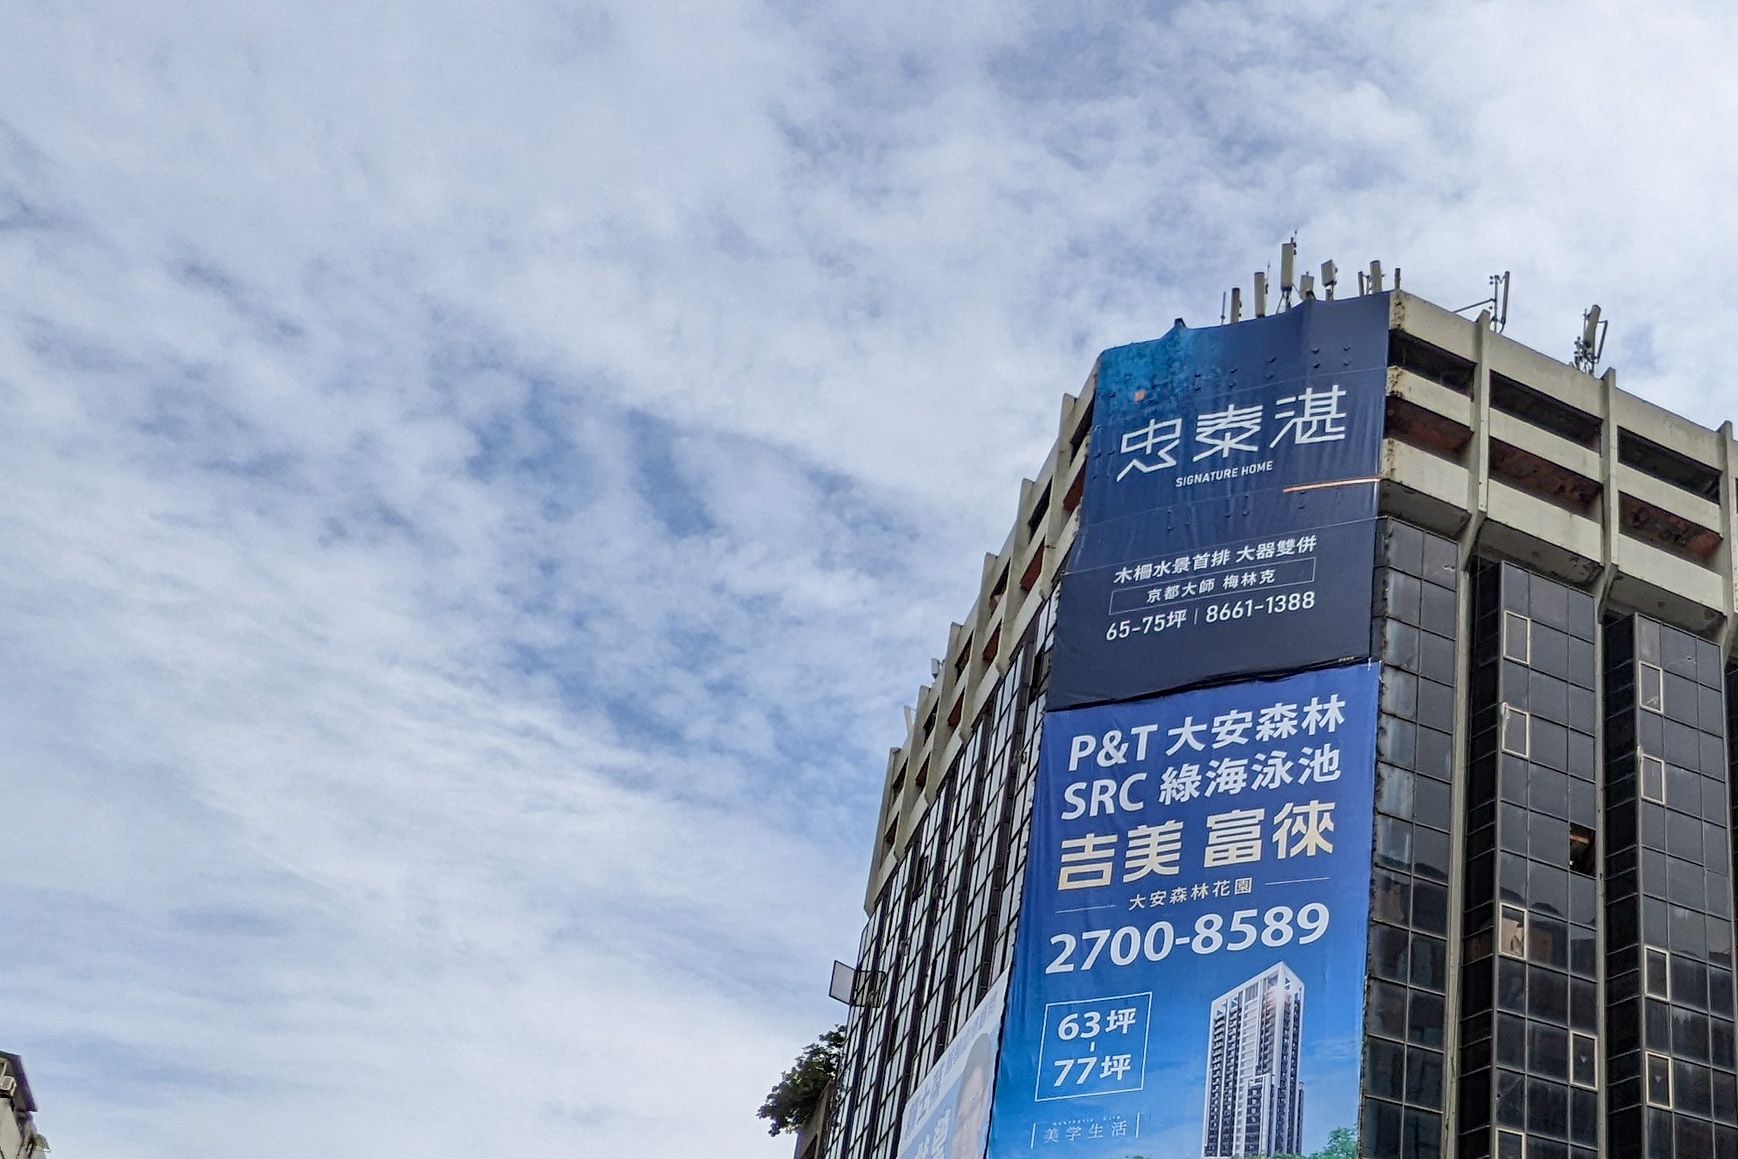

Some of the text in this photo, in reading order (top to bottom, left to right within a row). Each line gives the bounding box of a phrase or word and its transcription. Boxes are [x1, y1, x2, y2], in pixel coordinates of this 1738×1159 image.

[1175, 460, 1274, 488] SIGNATURE HOME
[1113, 535, 1317, 584] 木柵水景首排 大器雙併
[1146, 569, 1276, 604] 京都大師 梅林克
[1105, 591, 1316, 641] 65-75坪 8661-1388
[1068, 694, 1347, 771] P&T 大安森林
[1061, 744, 1342, 820] SRC 綠海泳池
[1056, 799, 1337, 892] 吉美 富徠
[1128, 876, 1254, 911] 大安森林花園
[1045, 902, 1331, 975] 2700-8589
[1056, 1006, 1137, 1040] 63坪
[1053, 1053, 1132, 1087] 77坪
